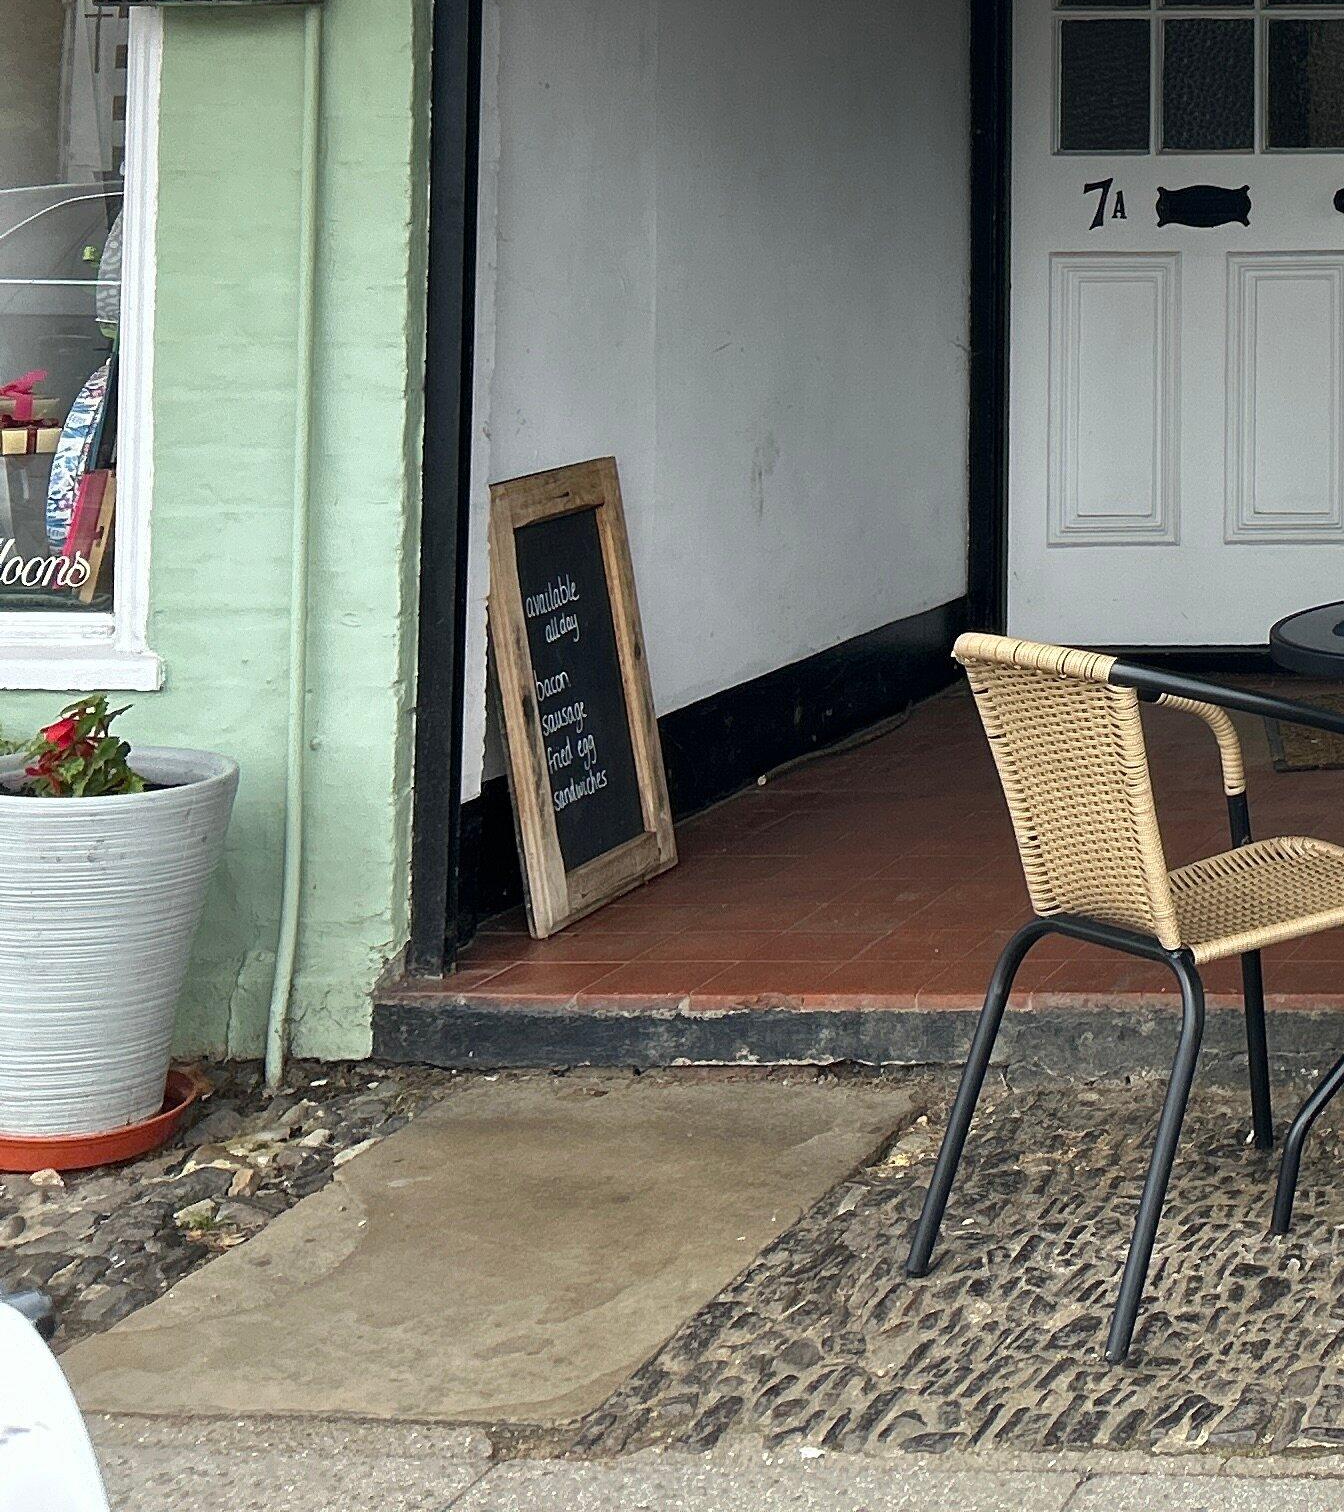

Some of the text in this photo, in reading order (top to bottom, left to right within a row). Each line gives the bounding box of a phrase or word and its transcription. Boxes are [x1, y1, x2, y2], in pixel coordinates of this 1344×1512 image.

[526, 575, 580, 618] available
[534, 670, 572, 701] bacon
[542, 701, 587, 736] sausage
[548, 734, 597, 774] fried egg
[554, 769, 608, 811] sandwiches
